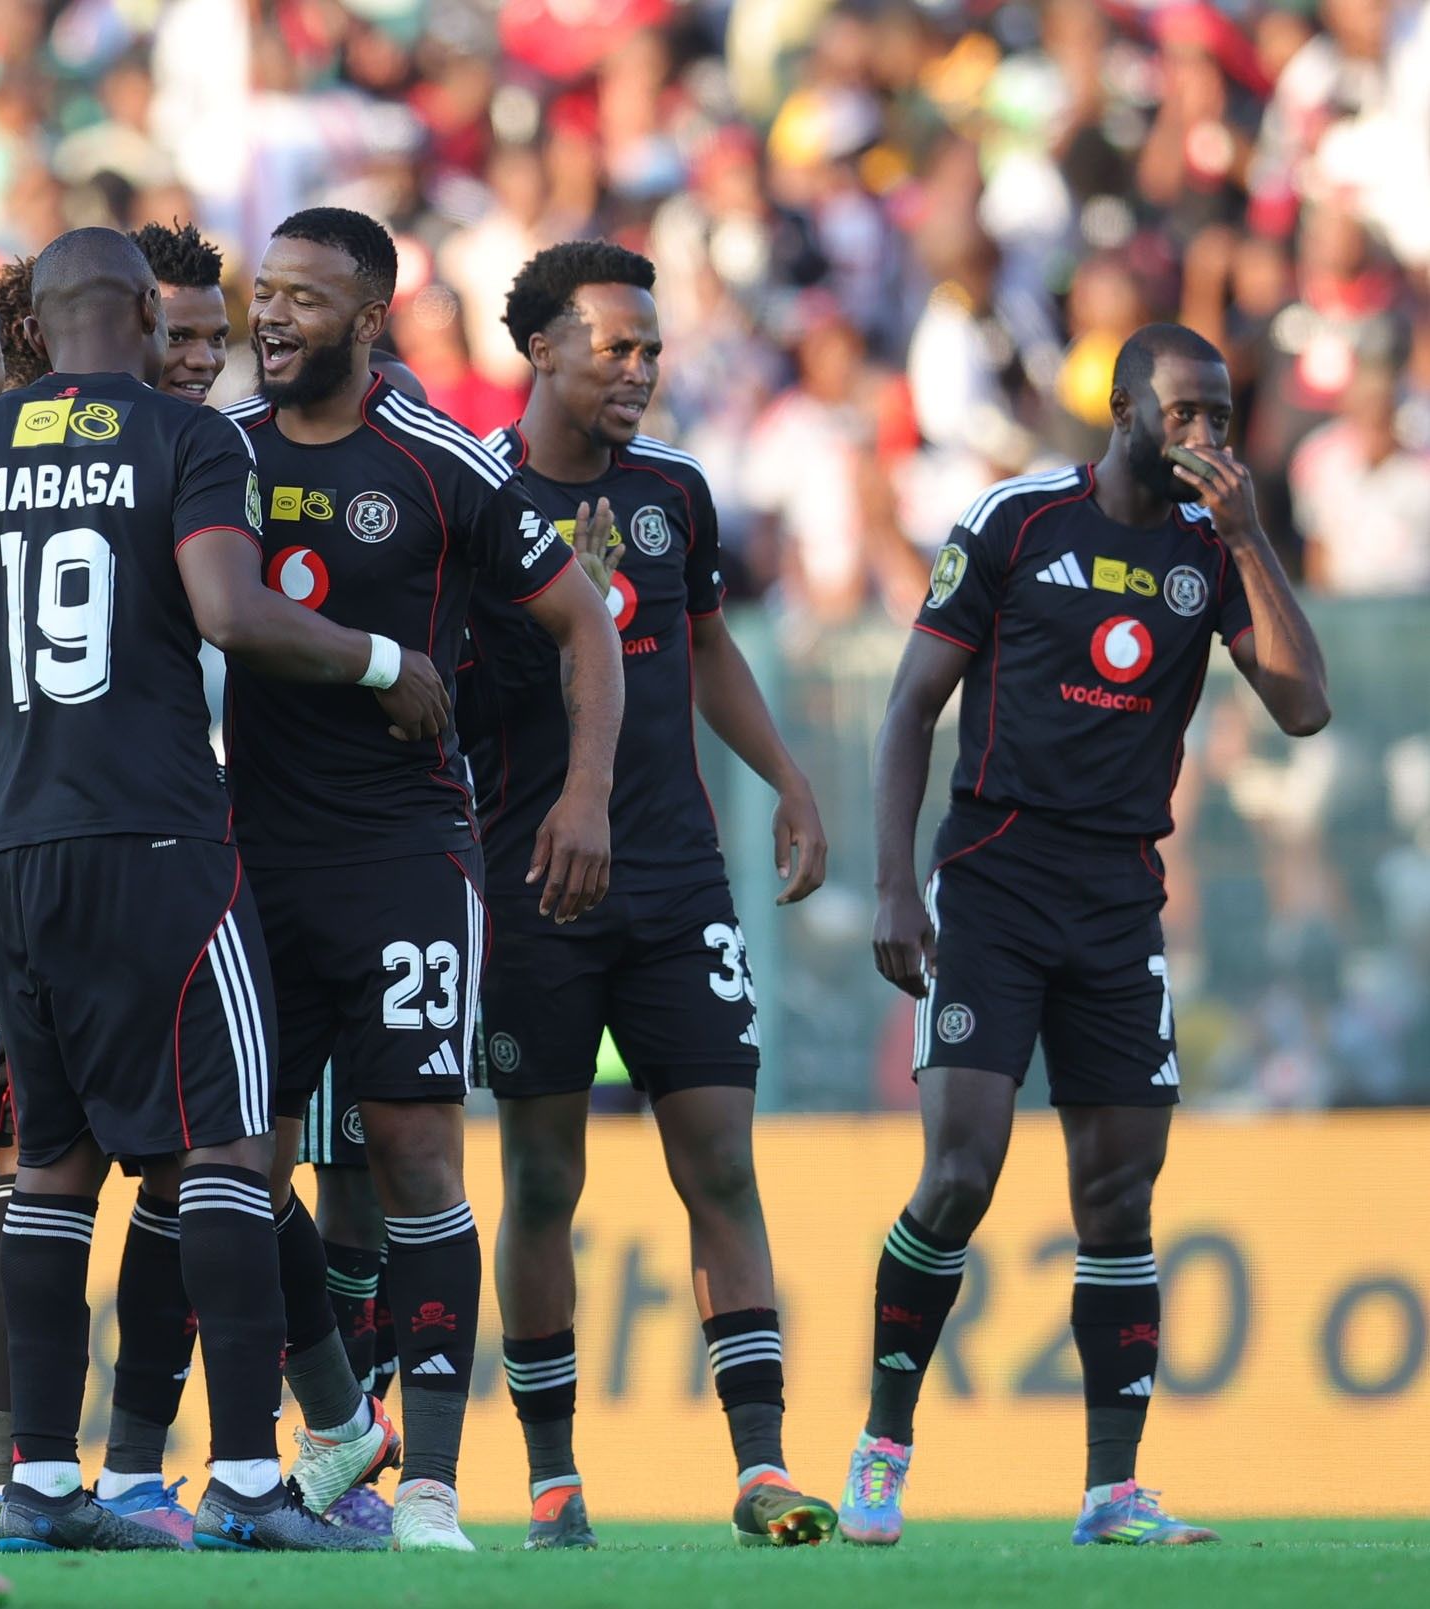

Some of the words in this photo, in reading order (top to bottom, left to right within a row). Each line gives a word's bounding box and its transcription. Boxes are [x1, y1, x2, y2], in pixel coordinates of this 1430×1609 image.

[32, 415, 51, 426] MTN
[69, 402, 120, 441] 8
[301, 491, 334, 520] 8
[0, 527, 116, 713] 19
[1060, 683, 1152, 713] vodacom
[381, 940, 460, 1030] 23
